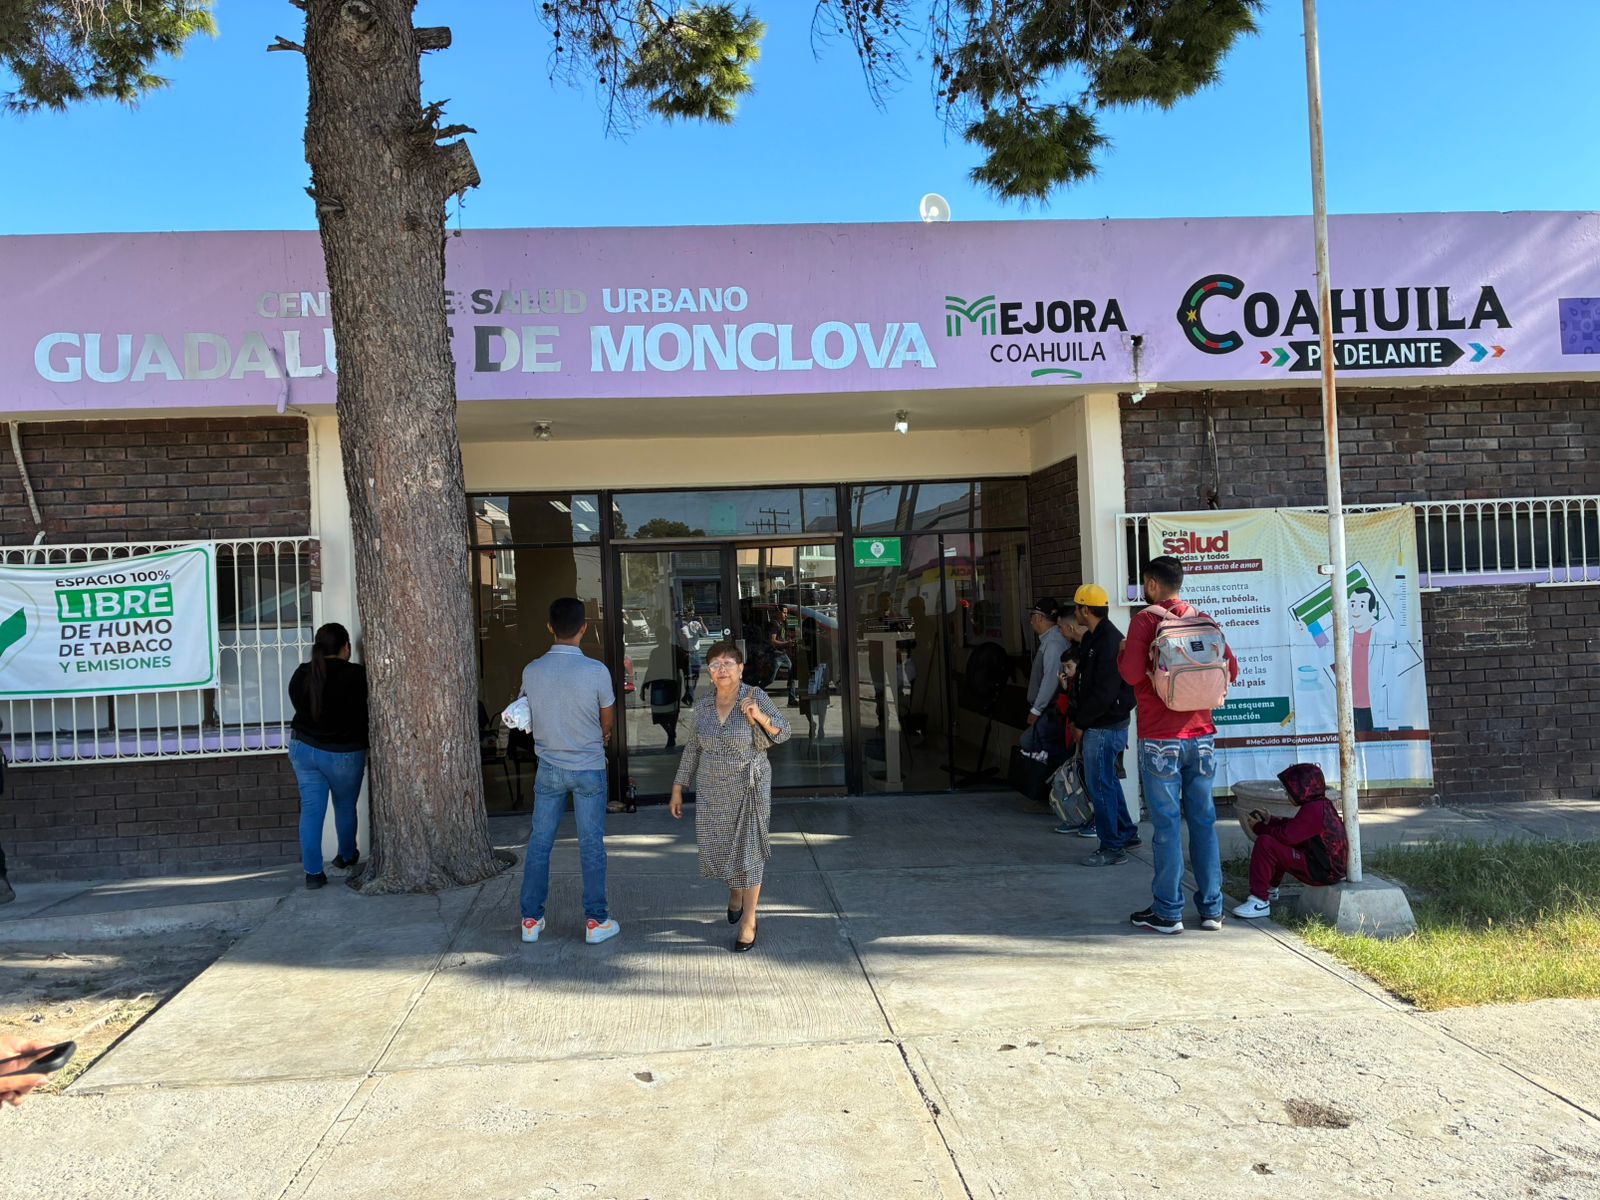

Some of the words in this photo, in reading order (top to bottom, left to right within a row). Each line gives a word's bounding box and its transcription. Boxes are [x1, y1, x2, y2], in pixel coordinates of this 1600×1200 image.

[257, 291, 331, 318] CEN
[471, 288, 588, 315] SALUD
[602, 286, 748, 314] URBANO
[945, 294, 1129, 336] MEJORA
[1176, 273, 1513, 355] COAHUILA
[34, 328, 337, 383] GUADAL
[474, 325, 562, 373] DE
[590, 319, 938, 373] MONCLOVA
[990, 342, 1107, 363] COAHUILA
[1163, 530, 1229, 554] salud
[1180, 529, 1188, 537] la
[55, 573, 126, 588] ESPACIO
[130, 569, 171, 583] 100%
[1185, 584, 1220, 593] vacunas
[1222, 583, 1249, 591] contra
[59, 587, 172, 619] LIBRE
[1214, 605, 1271, 617] poliomielitis
[61, 624, 91, 640] DE
[98, 618, 172, 638] HUMO
[1225, 619, 1260, 627] eficaces
[58, 643, 85, 657] DE
[90, 638, 173, 655] TABACO
[1260, 653, 1273, 661] los
[59, 661, 71, 674] Y
[76, 655, 172, 673] EMISIONES
[1255, 666, 1267, 674] las
[1231, 679, 1245, 687] del
[1247, 678, 1266, 688] país
[1238, 701, 1275, 710] esquema
[1213, 712, 1261, 721] vacunación
[1246, 737, 1280, 745] #MeCuido
